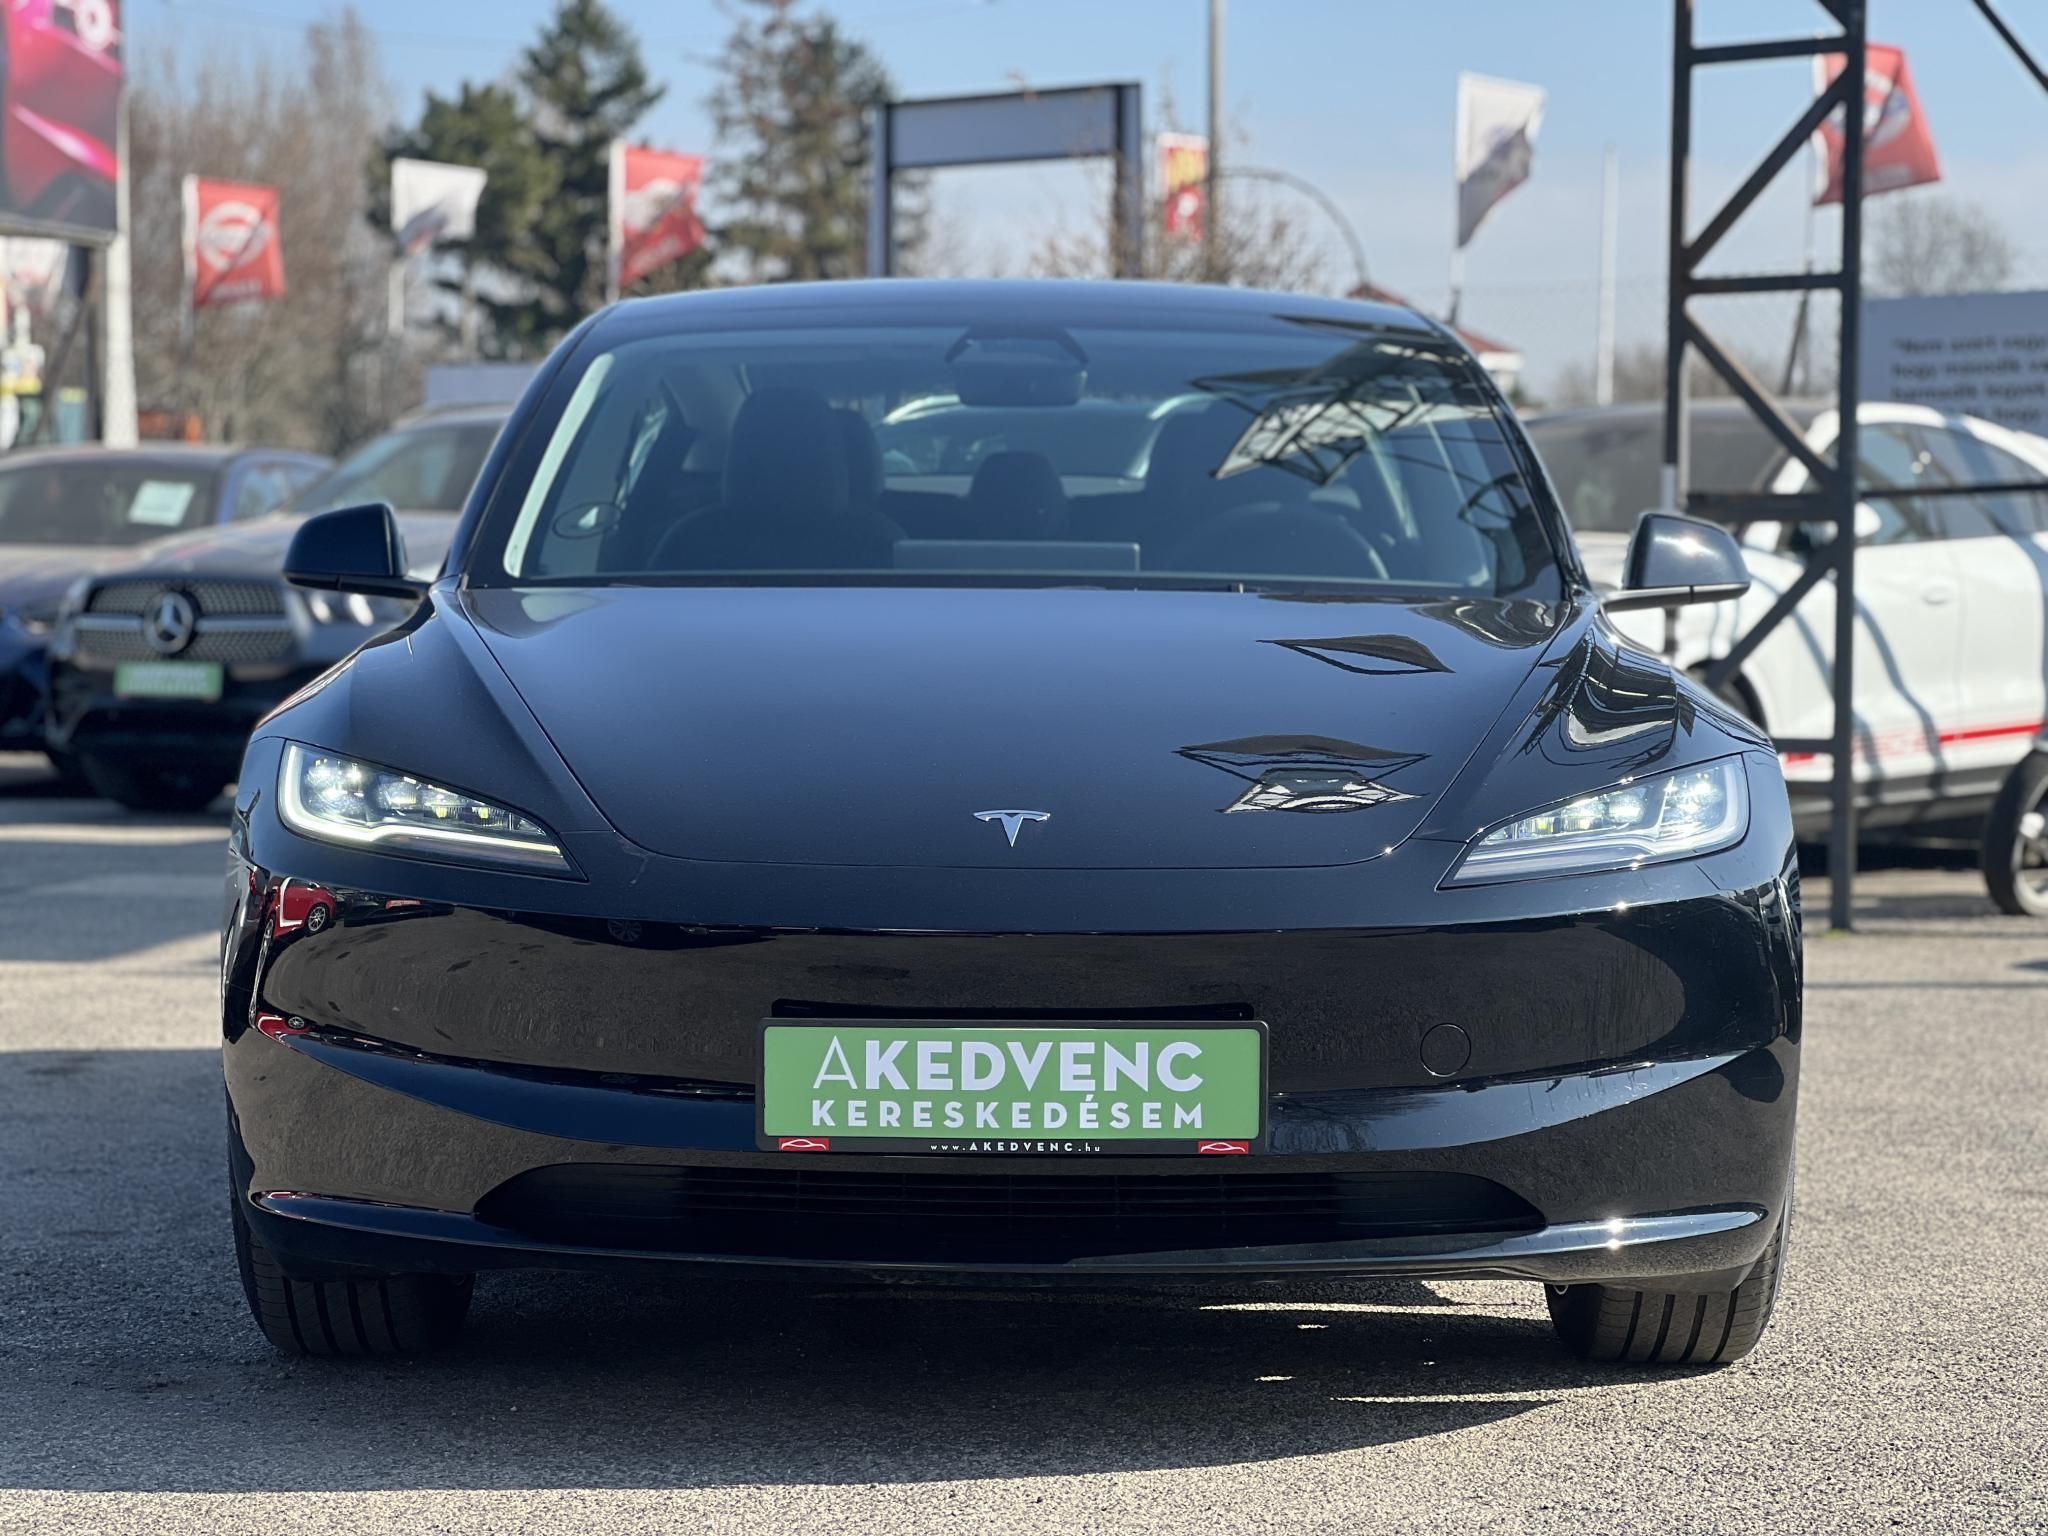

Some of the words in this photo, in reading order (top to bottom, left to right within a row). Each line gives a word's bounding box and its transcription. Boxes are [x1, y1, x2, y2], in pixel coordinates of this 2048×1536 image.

[813, 1035, 1203, 1092] AKEDVENC
[812, 1094, 1202, 1128] KERESKEDÉSEM
[930, 1141, 1101, 1152] www.AKEDVENC.hu
